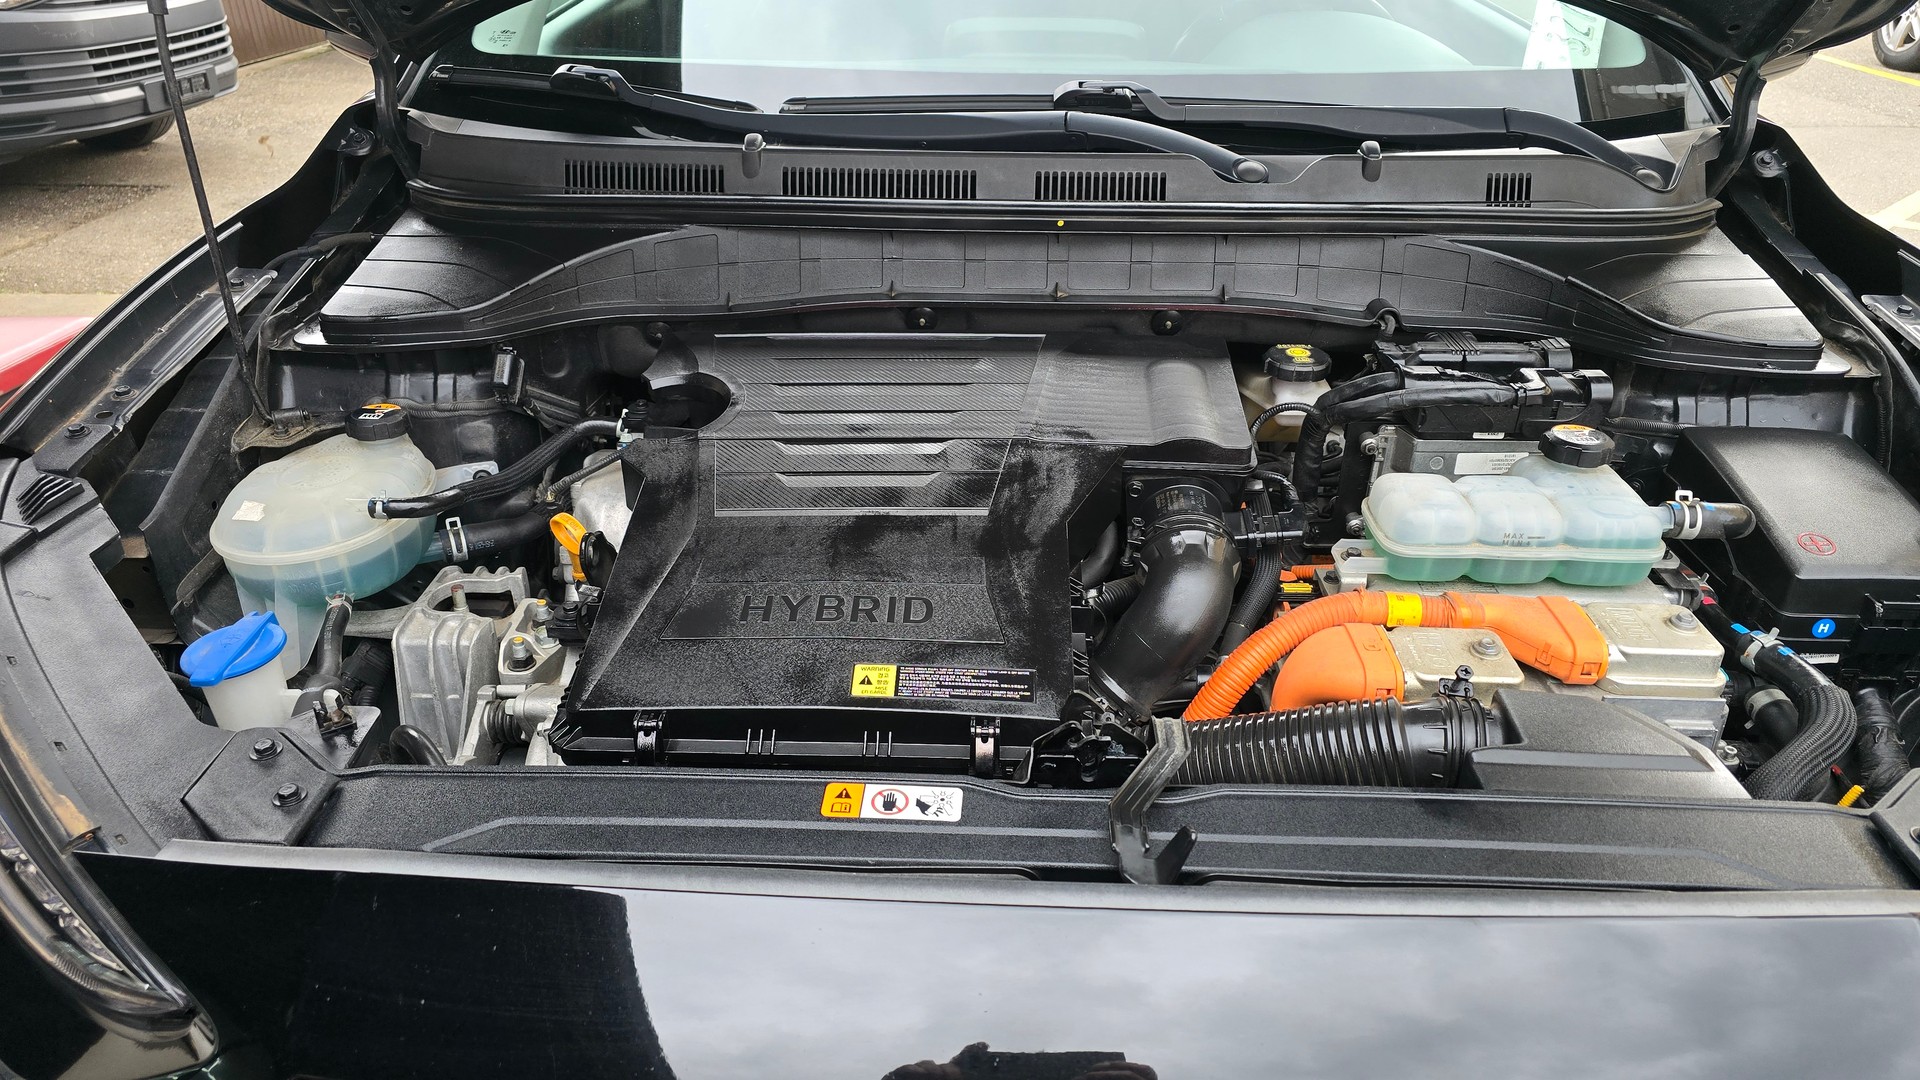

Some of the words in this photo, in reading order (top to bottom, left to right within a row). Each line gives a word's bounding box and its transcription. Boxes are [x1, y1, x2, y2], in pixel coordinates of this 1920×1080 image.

[1503, 532, 1525, 540] MAX
[739, 594, 934, 624] HYBRID
[1817, 623, 1830, 633] H
